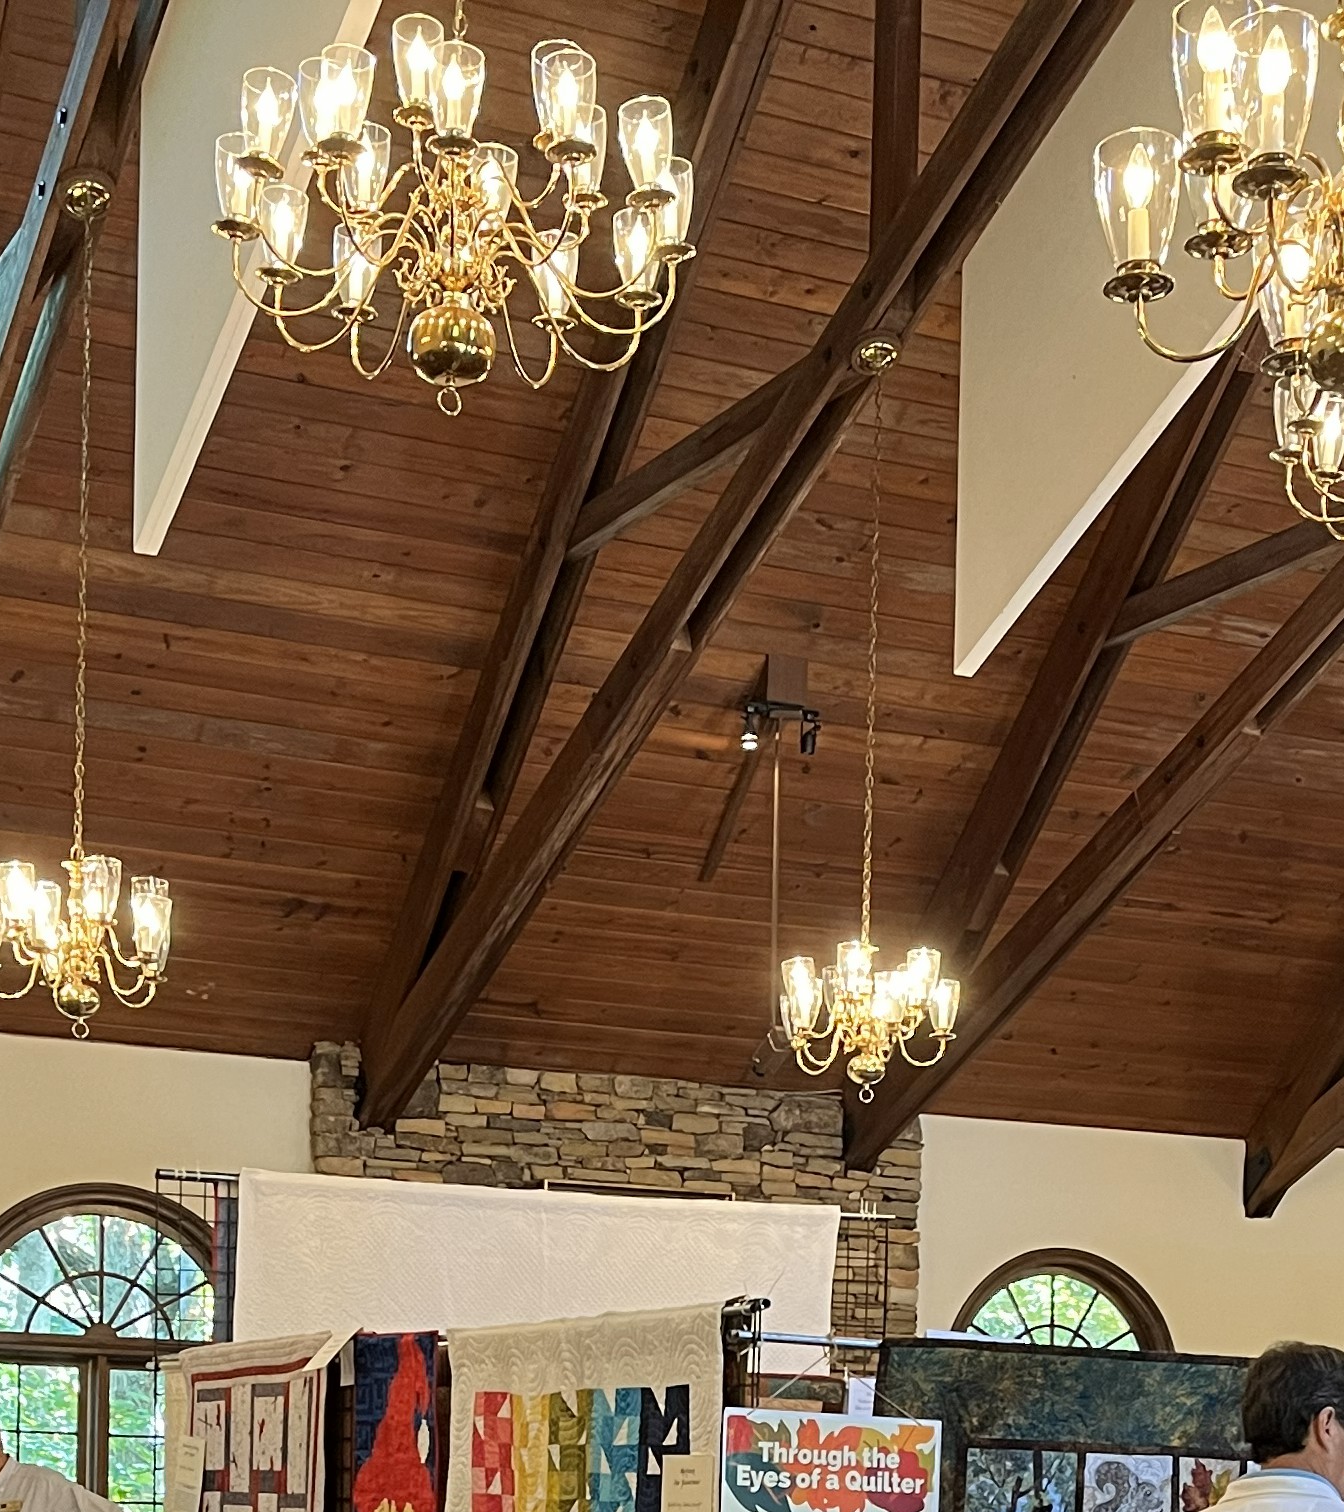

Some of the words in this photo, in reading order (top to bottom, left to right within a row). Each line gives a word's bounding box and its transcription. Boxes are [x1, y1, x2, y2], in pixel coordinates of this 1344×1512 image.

[758, 1441, 857, 1472] Through
[862, 1447, 901, 1469] the
[736, 1465, 791, 1493] Eyes
[796, 1468, 821, 1489] of
[825, 1475, 840, 1490] a
[845, 1470, 925, 1495] Quilter
